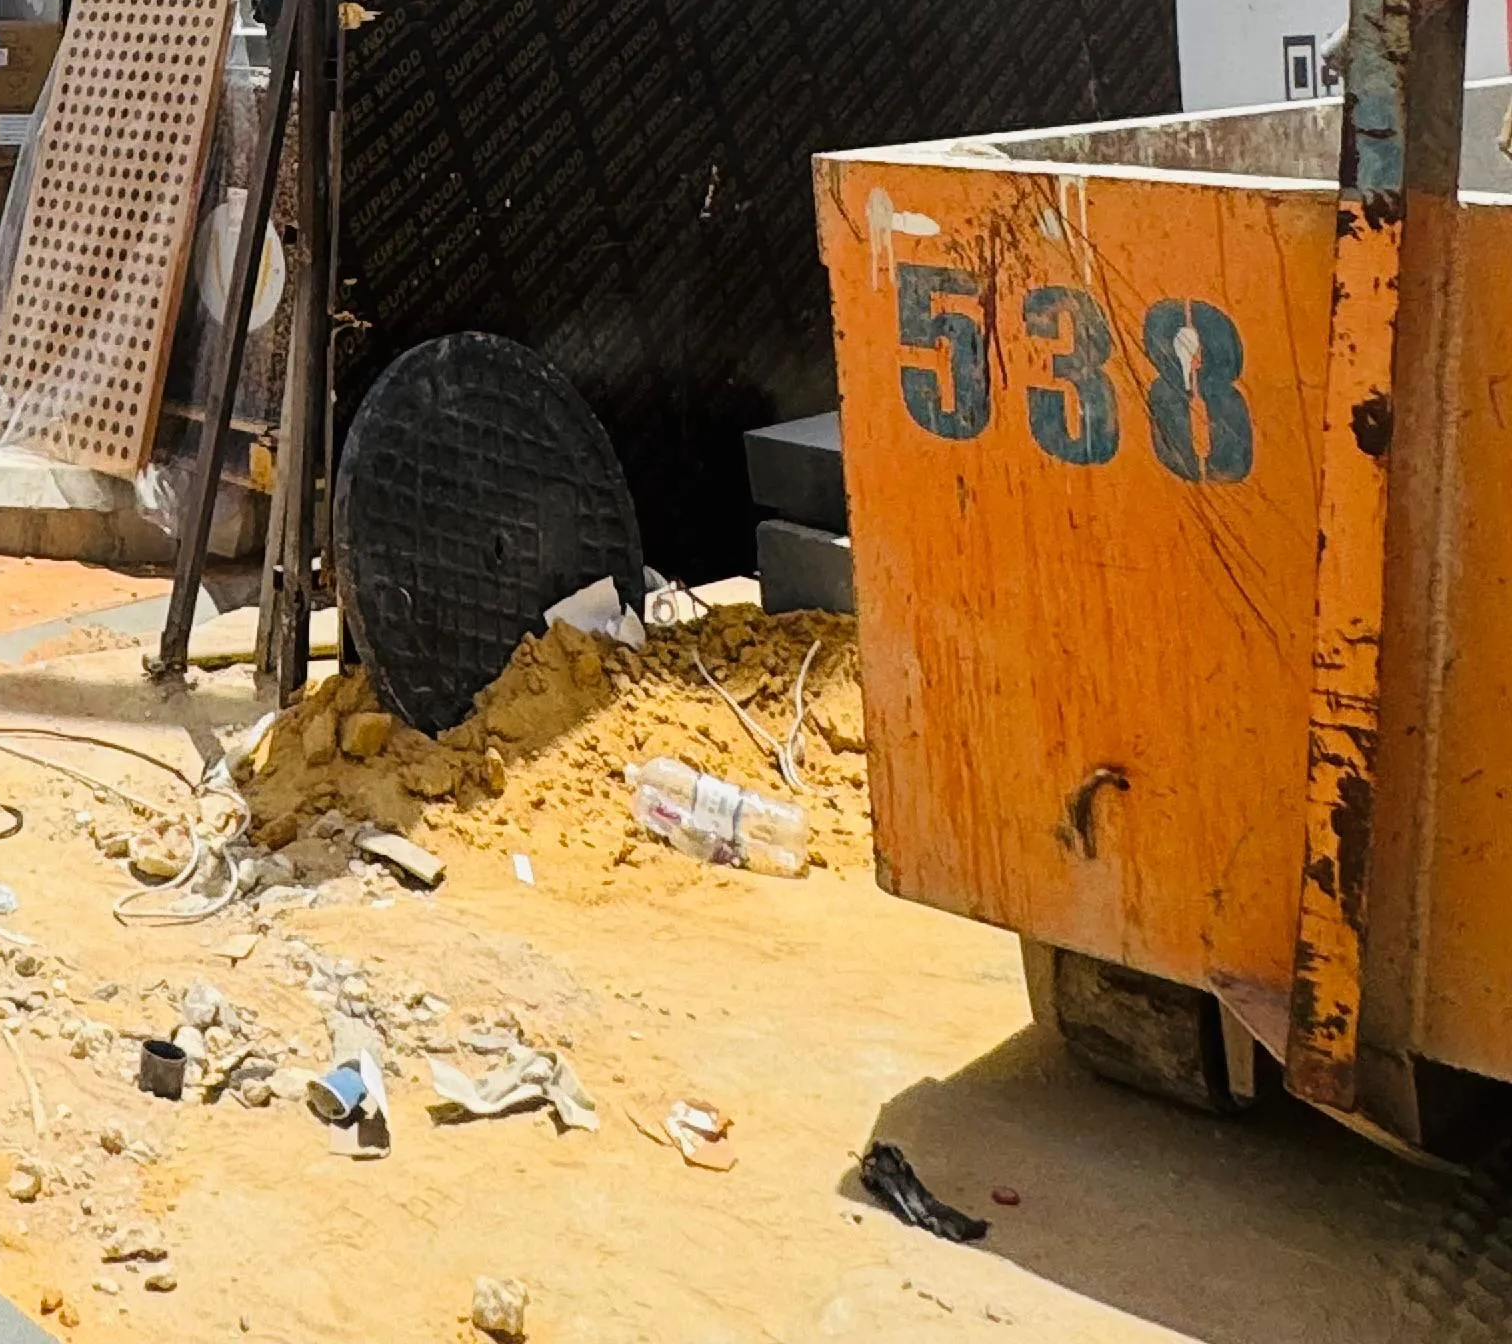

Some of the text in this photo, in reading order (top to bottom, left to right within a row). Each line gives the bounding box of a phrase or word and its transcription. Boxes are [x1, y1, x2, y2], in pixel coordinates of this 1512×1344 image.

[360, 7, 405, 55] WOOD
[376, 49, 421, 98] WOOD
[446, 33, 492, 86] SUPER
[458, 32, 547, 128] SUPER WOOD
[472, 70, 560, 169] SUPER WOOD
[345, 90, 435, 182] UPER WOOD
[351, 128, 448, 235] SUPER WOOD
[486, 153, 532, 208] SUPER
[528, 109, 571, 158] WOOD
[365, 218, 417, 276] SUPER
[898, 263, 1254, 485] 538
